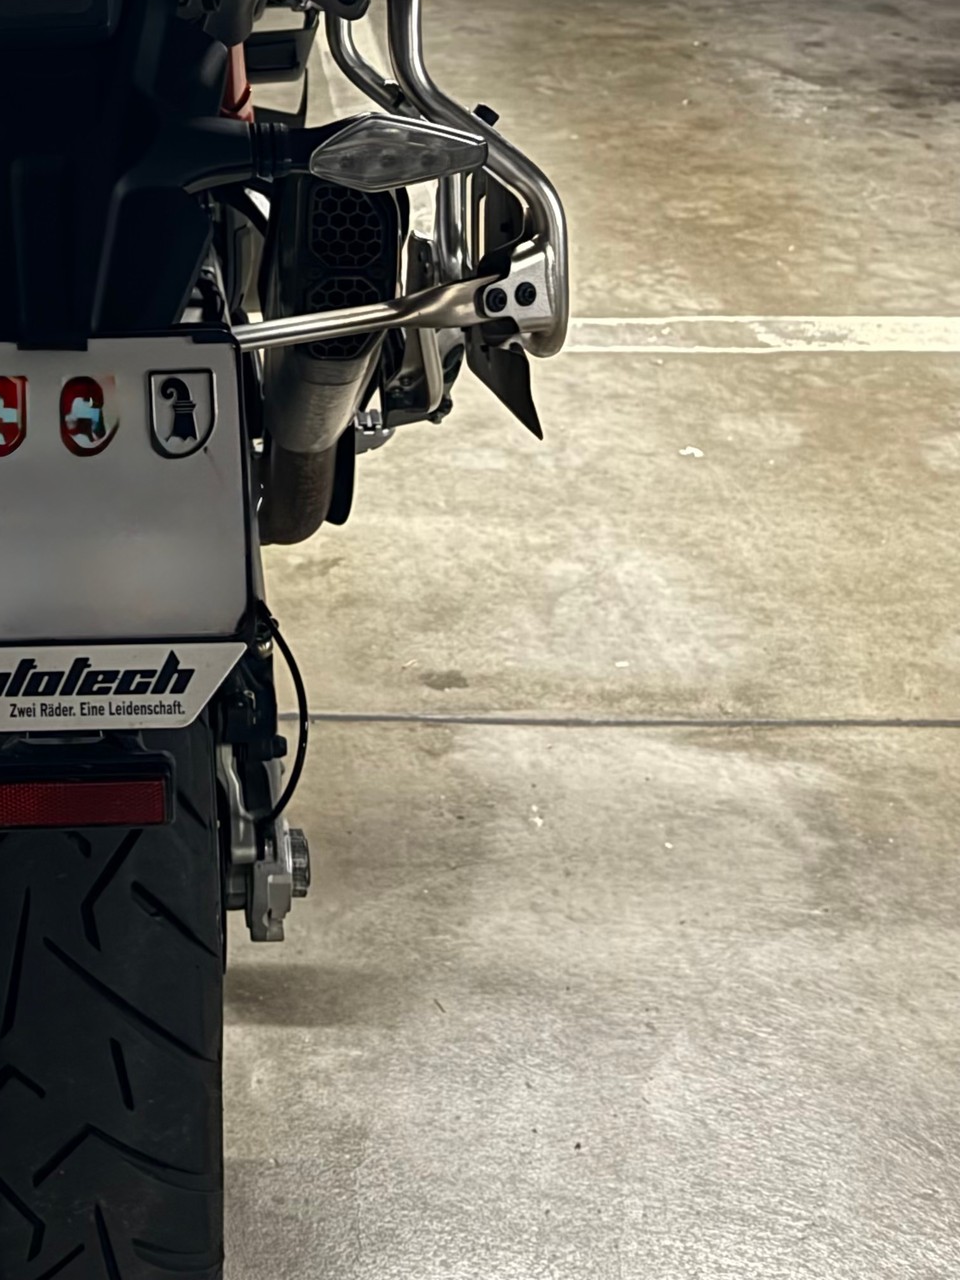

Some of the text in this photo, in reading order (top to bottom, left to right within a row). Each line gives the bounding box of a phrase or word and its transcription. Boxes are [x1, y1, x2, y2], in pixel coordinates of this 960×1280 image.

[10, 699, 186, 718] Zwei Räder. Eine Leidenschaft.
